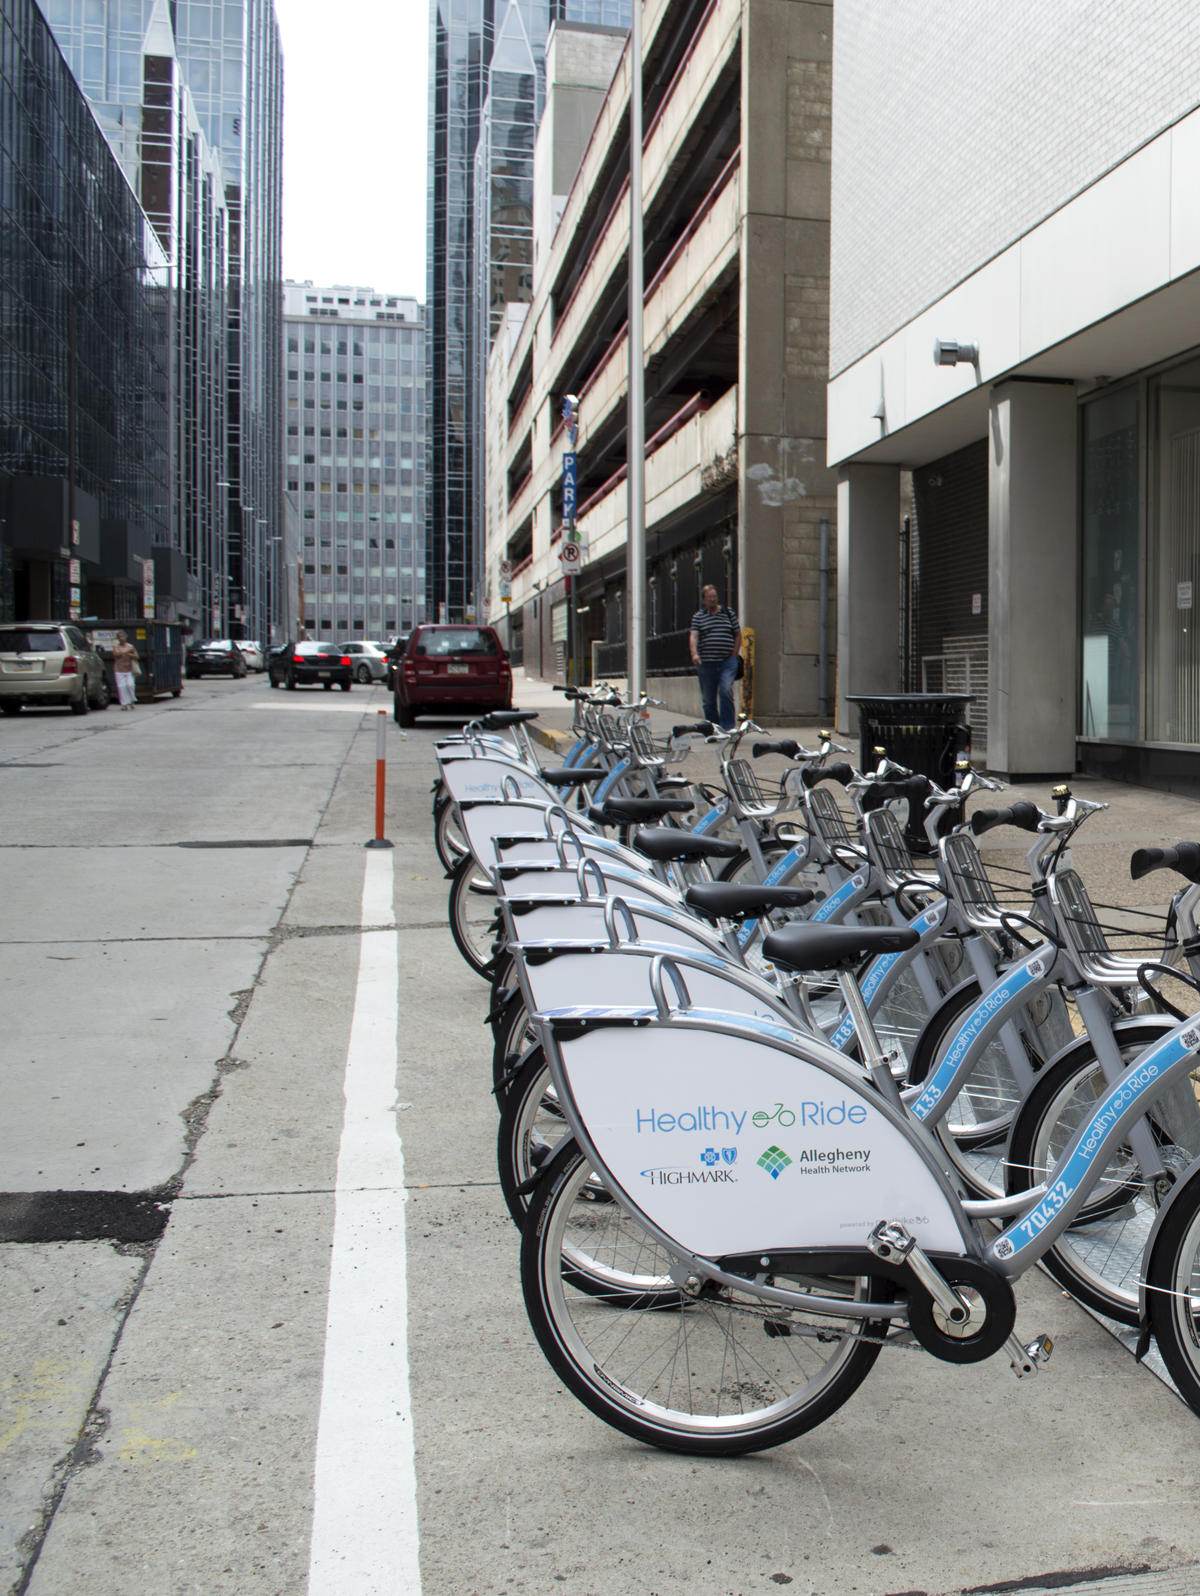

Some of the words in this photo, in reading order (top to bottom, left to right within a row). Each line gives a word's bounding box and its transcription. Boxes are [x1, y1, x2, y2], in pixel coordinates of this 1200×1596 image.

[823, 897, 841, 913] Ride
[945, 1021, 977, 1068] Healthy
[984, 987, 1010, 1014] Ride
[637, 1105, 747, 1135] Healthy
[801, 1100, 867, 1127] Ride
[1078, 1104, 1116, 1160] Healthy
[1128, 1063, 1159, 1094] Ride
[800, 1148, 871, 1164] Allegheny
[650, 1169, 735, 1185] HIGHMARK
[800, 1166, 830, 1175] Health
[832, 1163, 871, 1174] Network
[1020, 1180, 1074, 1238] 70432
